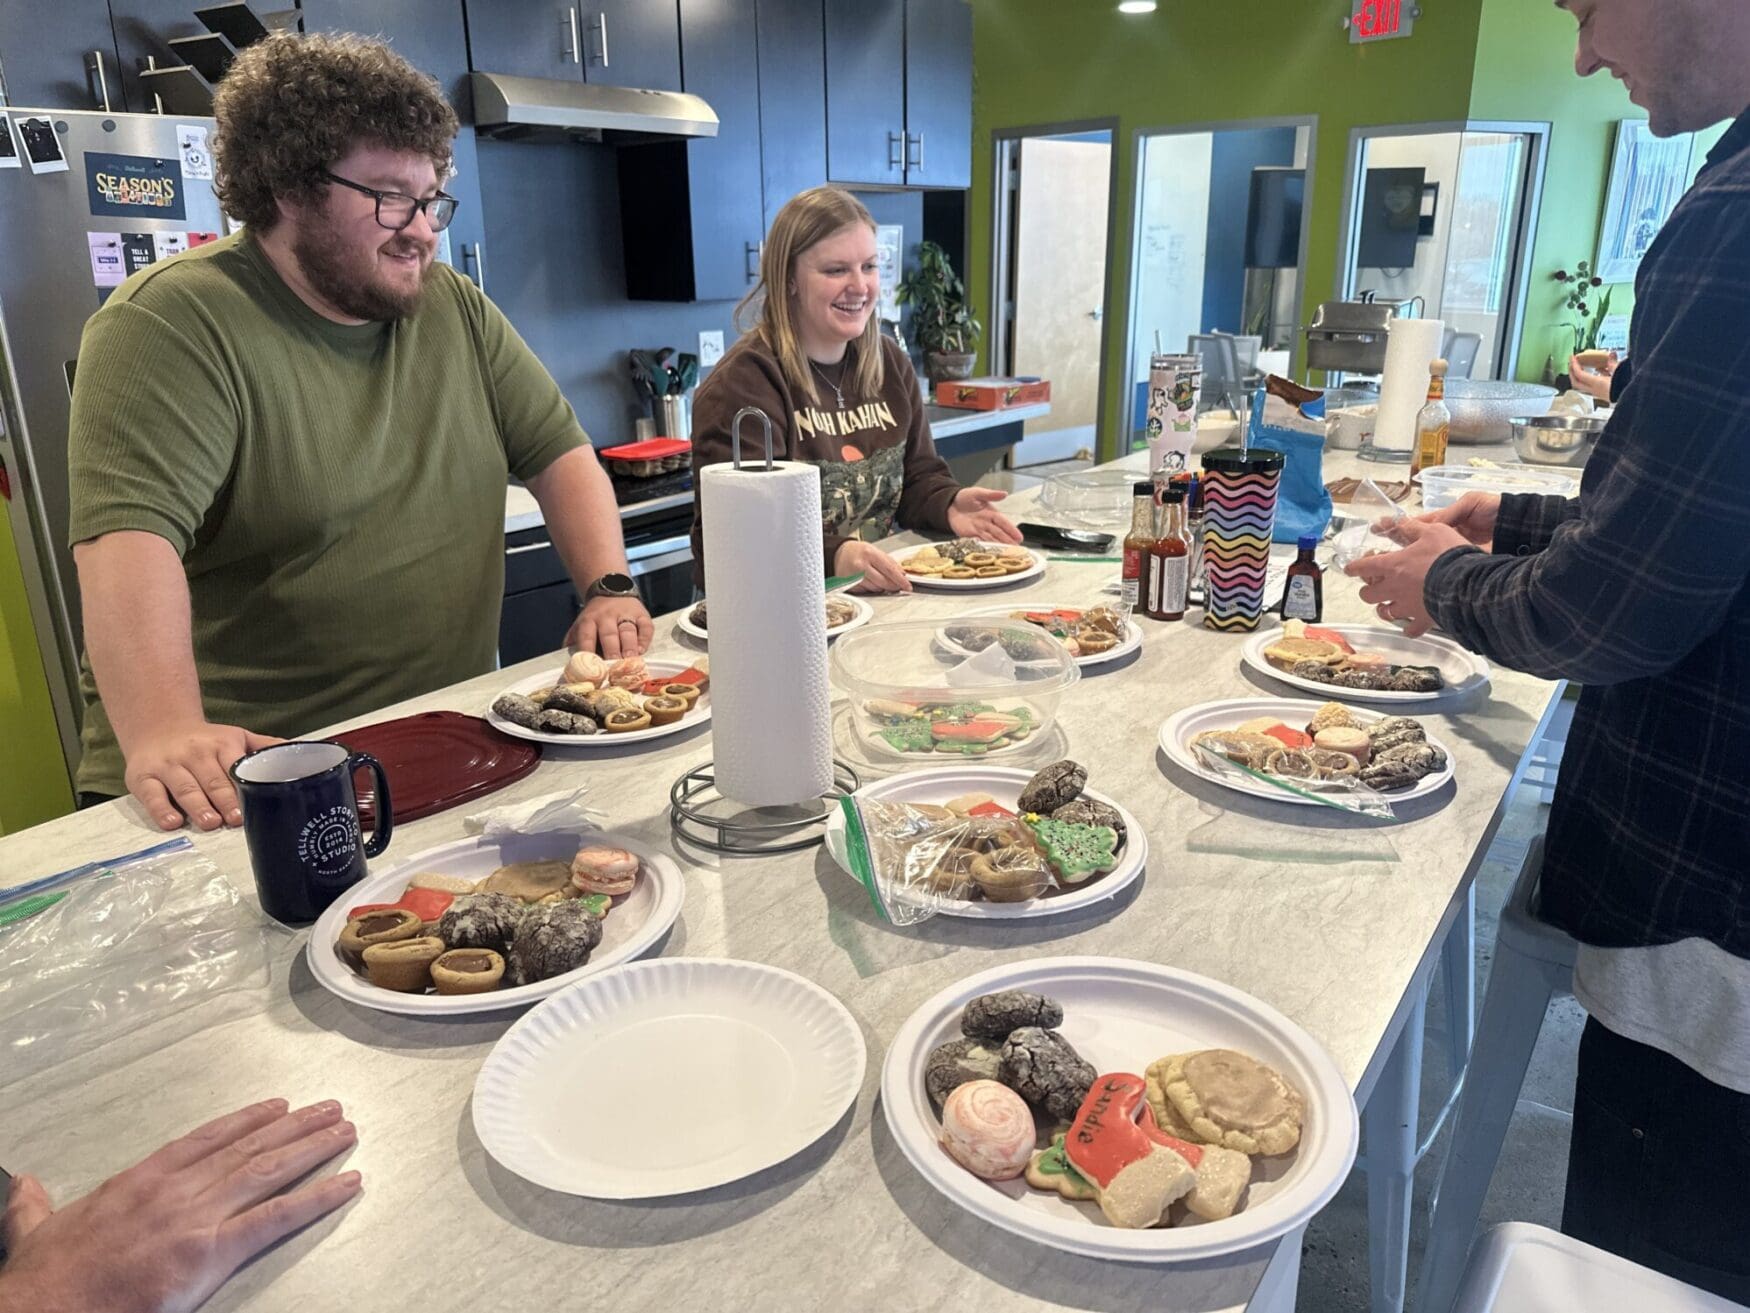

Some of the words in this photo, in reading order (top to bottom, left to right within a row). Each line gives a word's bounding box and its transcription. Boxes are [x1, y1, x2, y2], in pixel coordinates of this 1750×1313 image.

[96, 173, 175, 199] SEASON'S
[298, 813, 328, 863] TELLWELL
[330, 806, 355, 820] STORY
[320, 843, 357, 863] STUDIO
